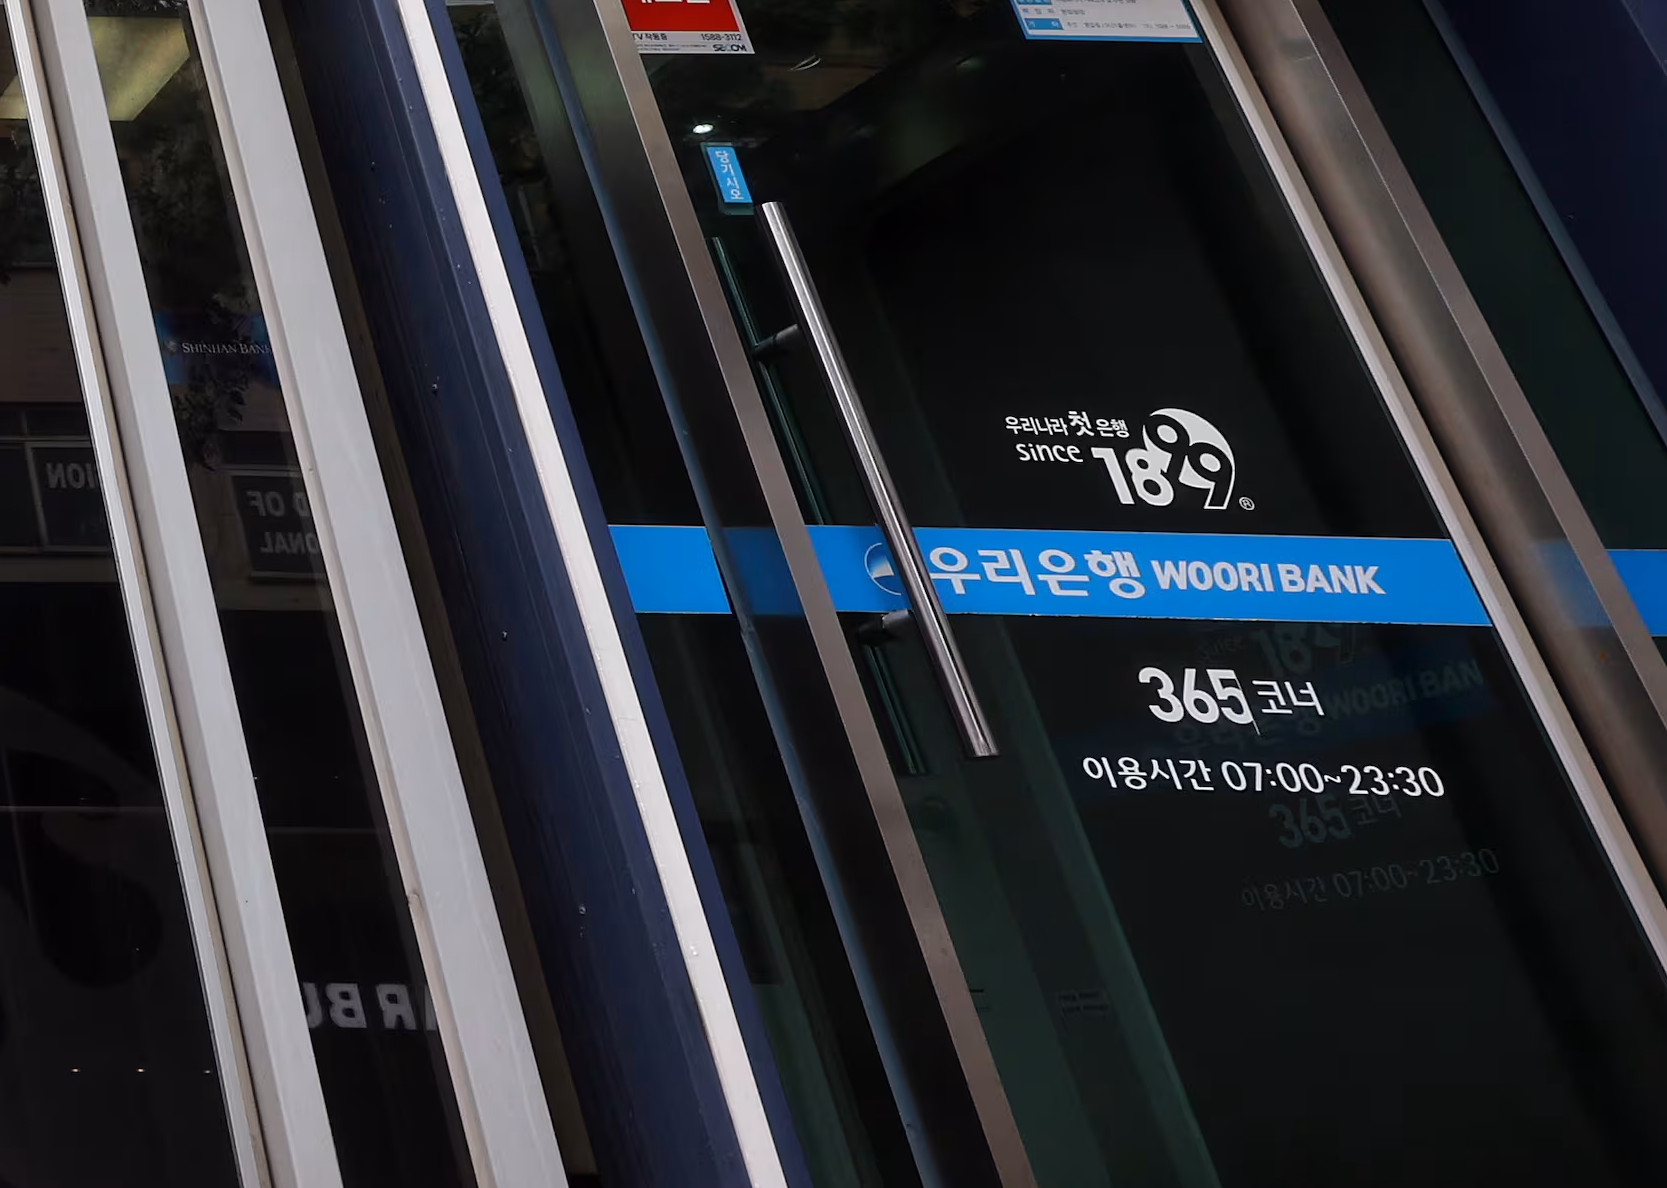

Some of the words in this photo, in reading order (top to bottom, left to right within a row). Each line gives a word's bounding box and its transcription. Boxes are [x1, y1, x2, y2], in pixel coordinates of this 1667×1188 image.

[701, 33, 742, 41] 1588-3112
[713, 43, 747, 52] SECOM
[714, 150, 744, 200] 당기시오
[1005, 415, 1069, 437] 우리나라
[1068, 410, 1095, 437] 첫
[1096, 418, 1130, 439] 은행
[929, 546, 1146, 599] 우리은행
[1150, 558, 1274, 593] WOORI
[1276, 563, 1387, 596] BANK
[1138, 666, 1256, 728] 365
[1252, 679, 1325, 717] 코너
[1082, 755, 1213, 794] 이용시간
[1221, 760, 1446, 799] 07:00~23:30
